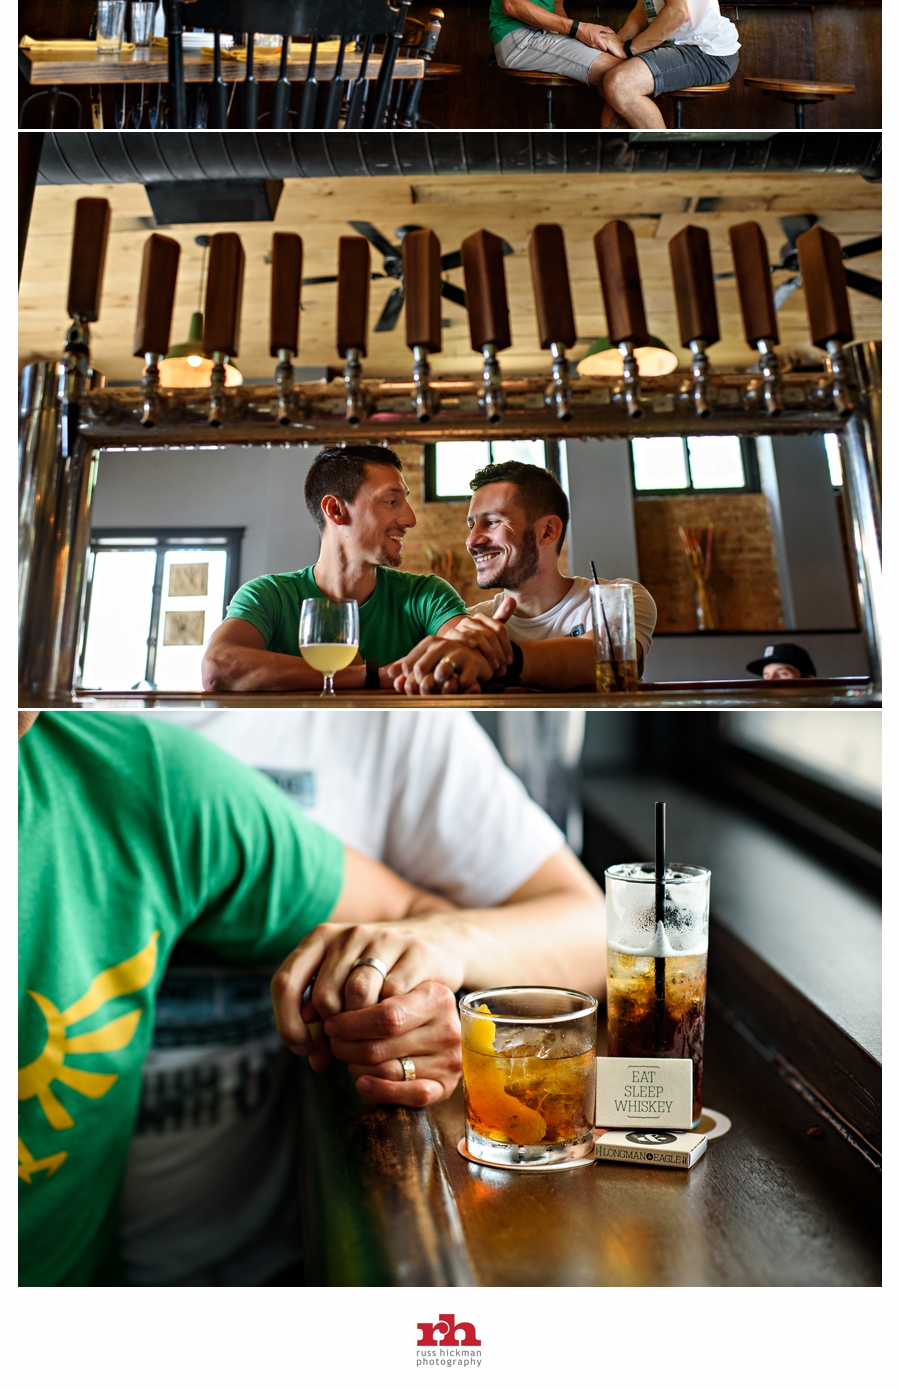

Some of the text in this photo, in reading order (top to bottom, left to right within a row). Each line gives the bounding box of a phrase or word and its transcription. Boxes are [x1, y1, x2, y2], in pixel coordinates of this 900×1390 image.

[632, 1070, 656, 1083] EAT
[624, 1085, 664, 1098] SLEEP
[614, 1100, 673, 1113] WHISKEY
[603, 1148, 646, 1161] LONGMAN
[654, 1153, 682, 1165] EAGLE
